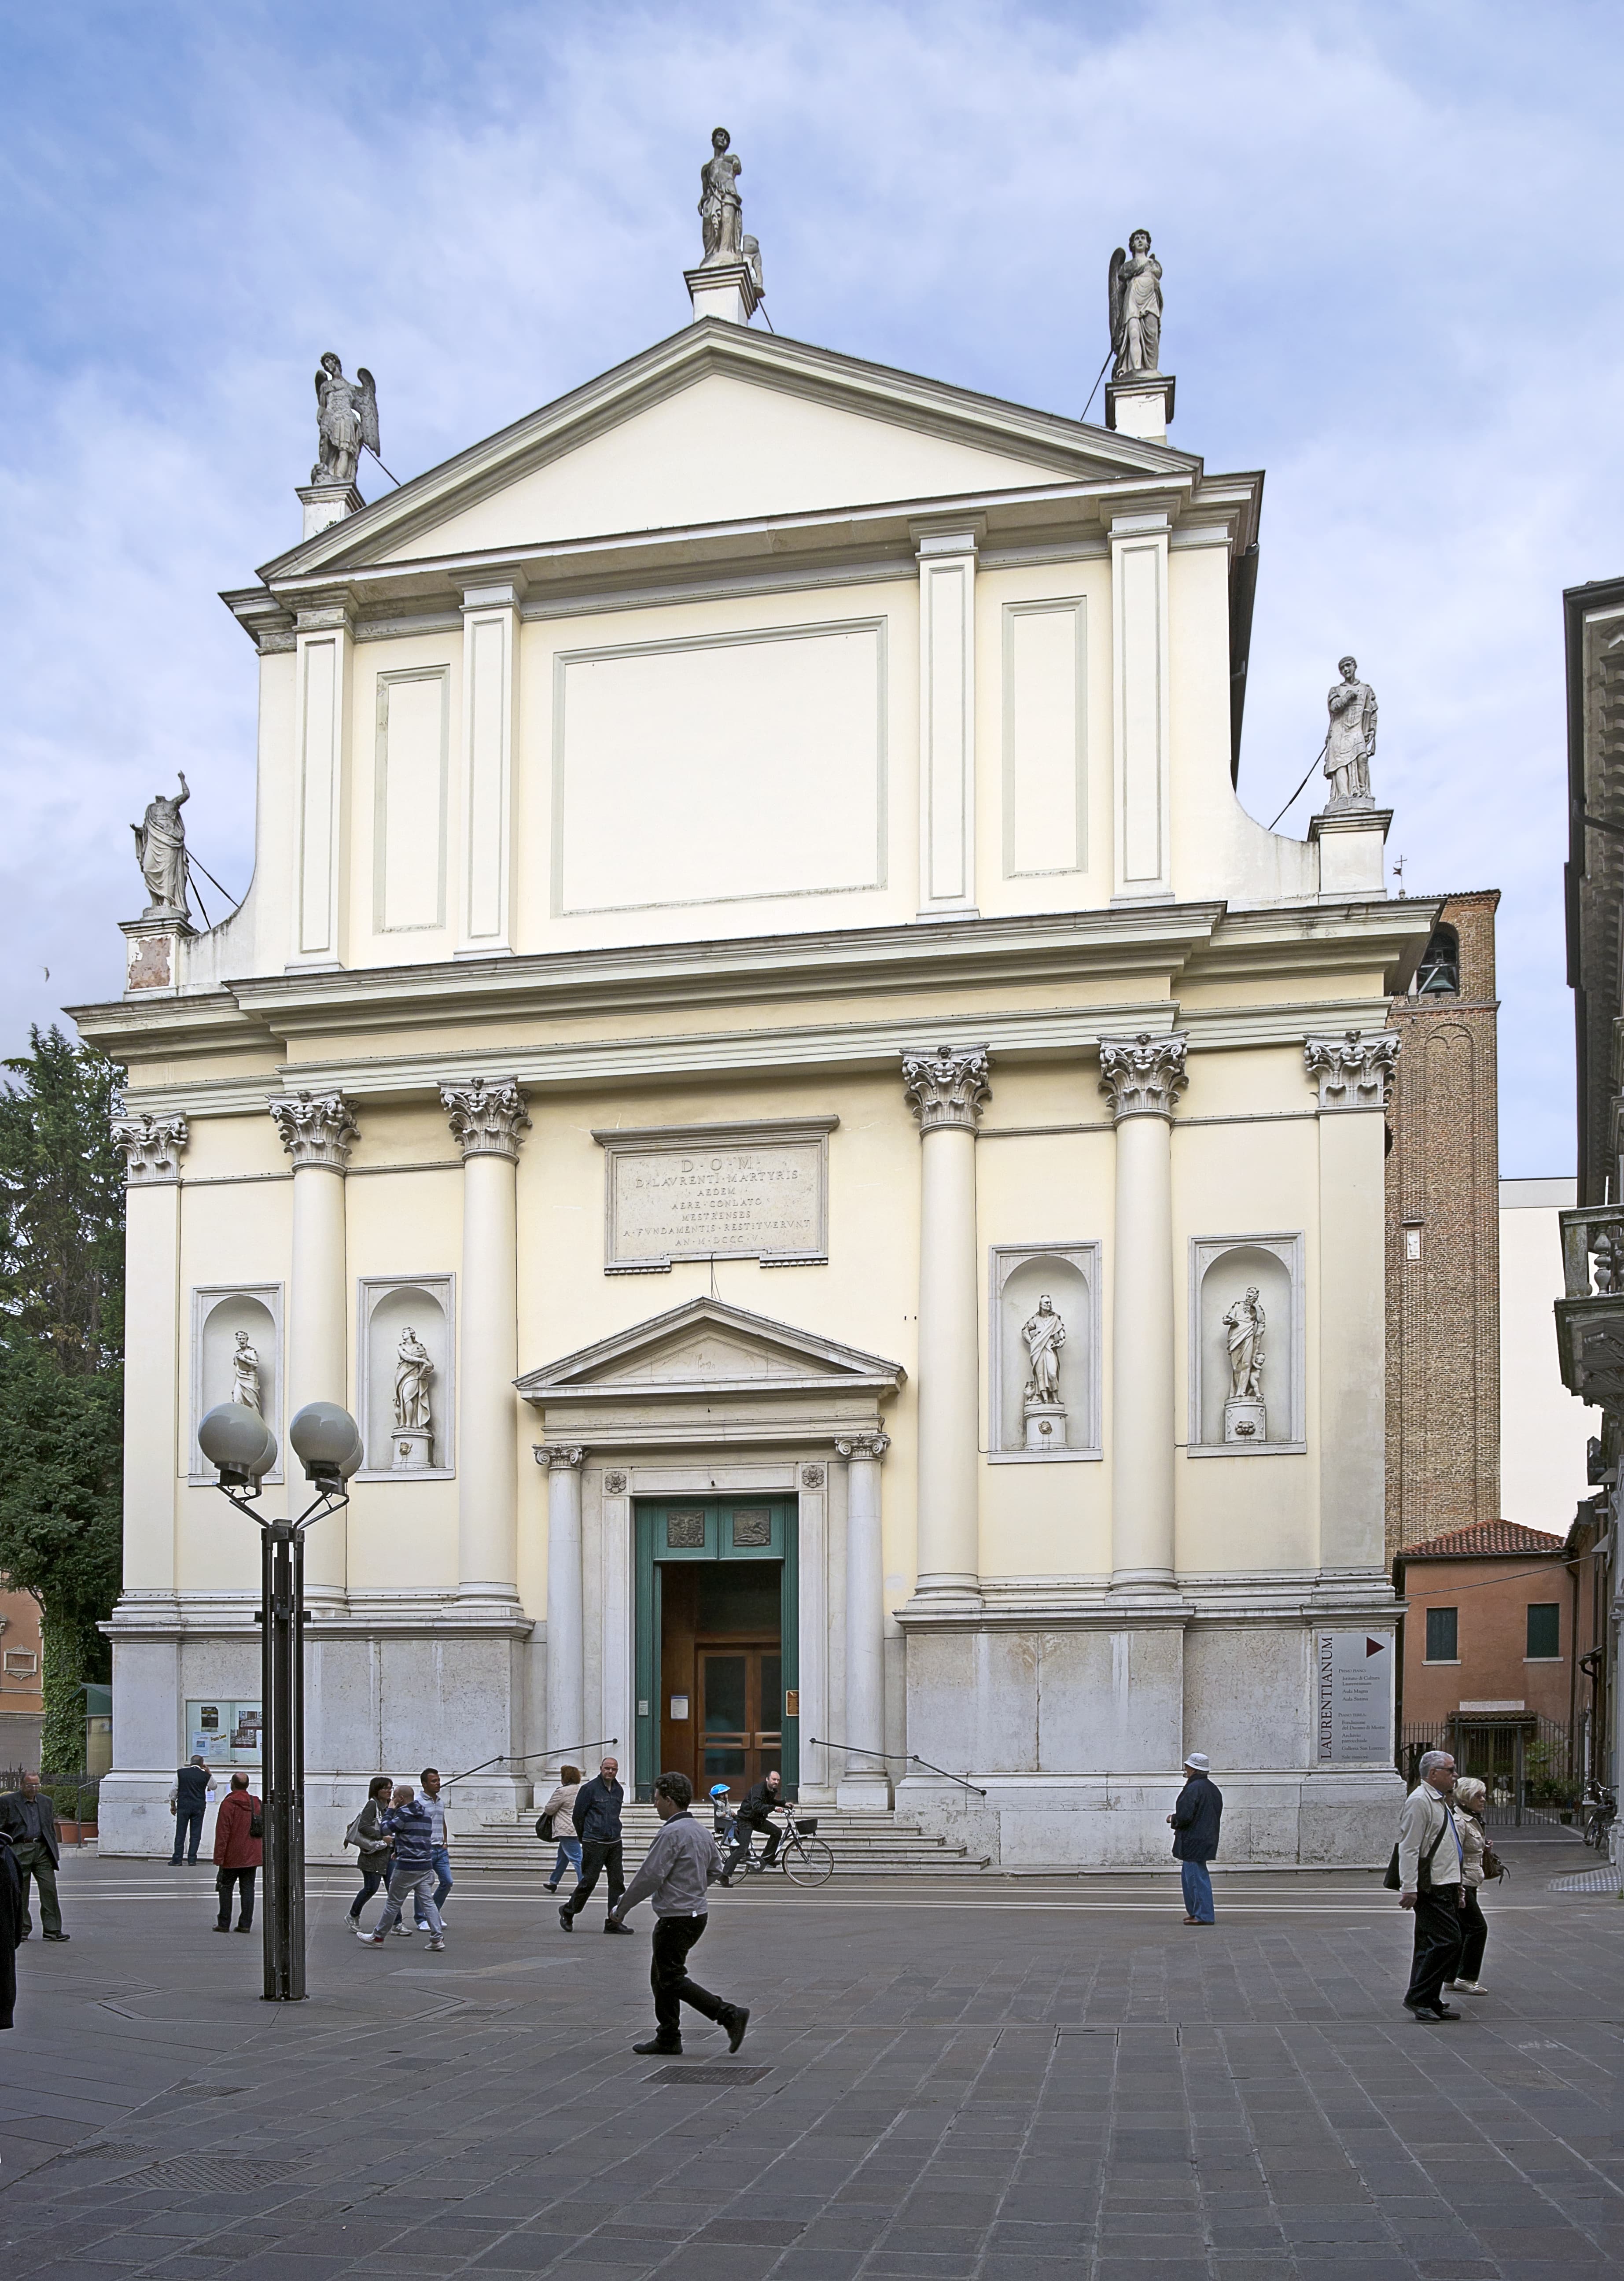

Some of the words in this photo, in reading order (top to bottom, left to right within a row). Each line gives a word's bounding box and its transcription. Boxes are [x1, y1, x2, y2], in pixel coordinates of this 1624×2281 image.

[697, 1187, 736, 1197] AEDEM
[682, 1211, 751, 1221] MESTRENSES
[1321, 1636, 1333, 1759] LAURENTIANUM
